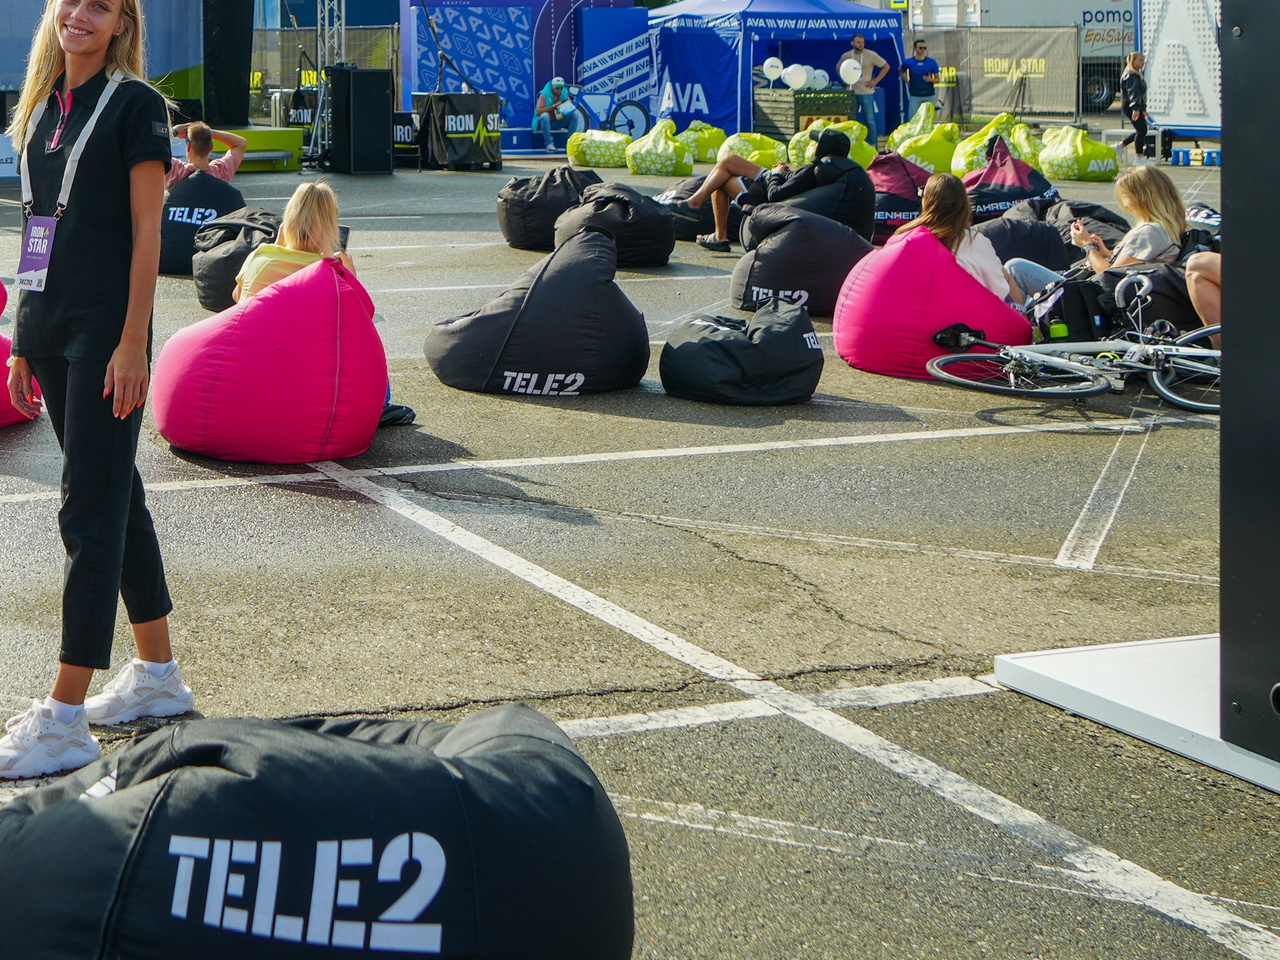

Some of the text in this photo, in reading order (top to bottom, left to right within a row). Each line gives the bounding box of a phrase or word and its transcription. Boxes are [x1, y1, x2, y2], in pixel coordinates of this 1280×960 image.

[747, 18, 766, 27] AVA
[808, 19, 826, 28] AVA
[870, 19, 888, 28] AVA
[582, 60, 599, 74] AVA
[984, 58, 1046, 73] IRON STAR
[660, 82, 709, 114] AVA
[444, 114, 500, 132] IRON ST
[394, 125, 413, 143] IRO
[1088, 159, 1115, 172] AVA
[168, 206, 218, 225] TELE2
[875, 211, 919, 220] ENHEIT
[30, 226, 45, 238] IRON
[27, 238, 48, 254] STAR
[803, 332, 821, 349] TEL
[503, 371, 585, 396] TELE2
[169, 831, 447, 953] TELE2
